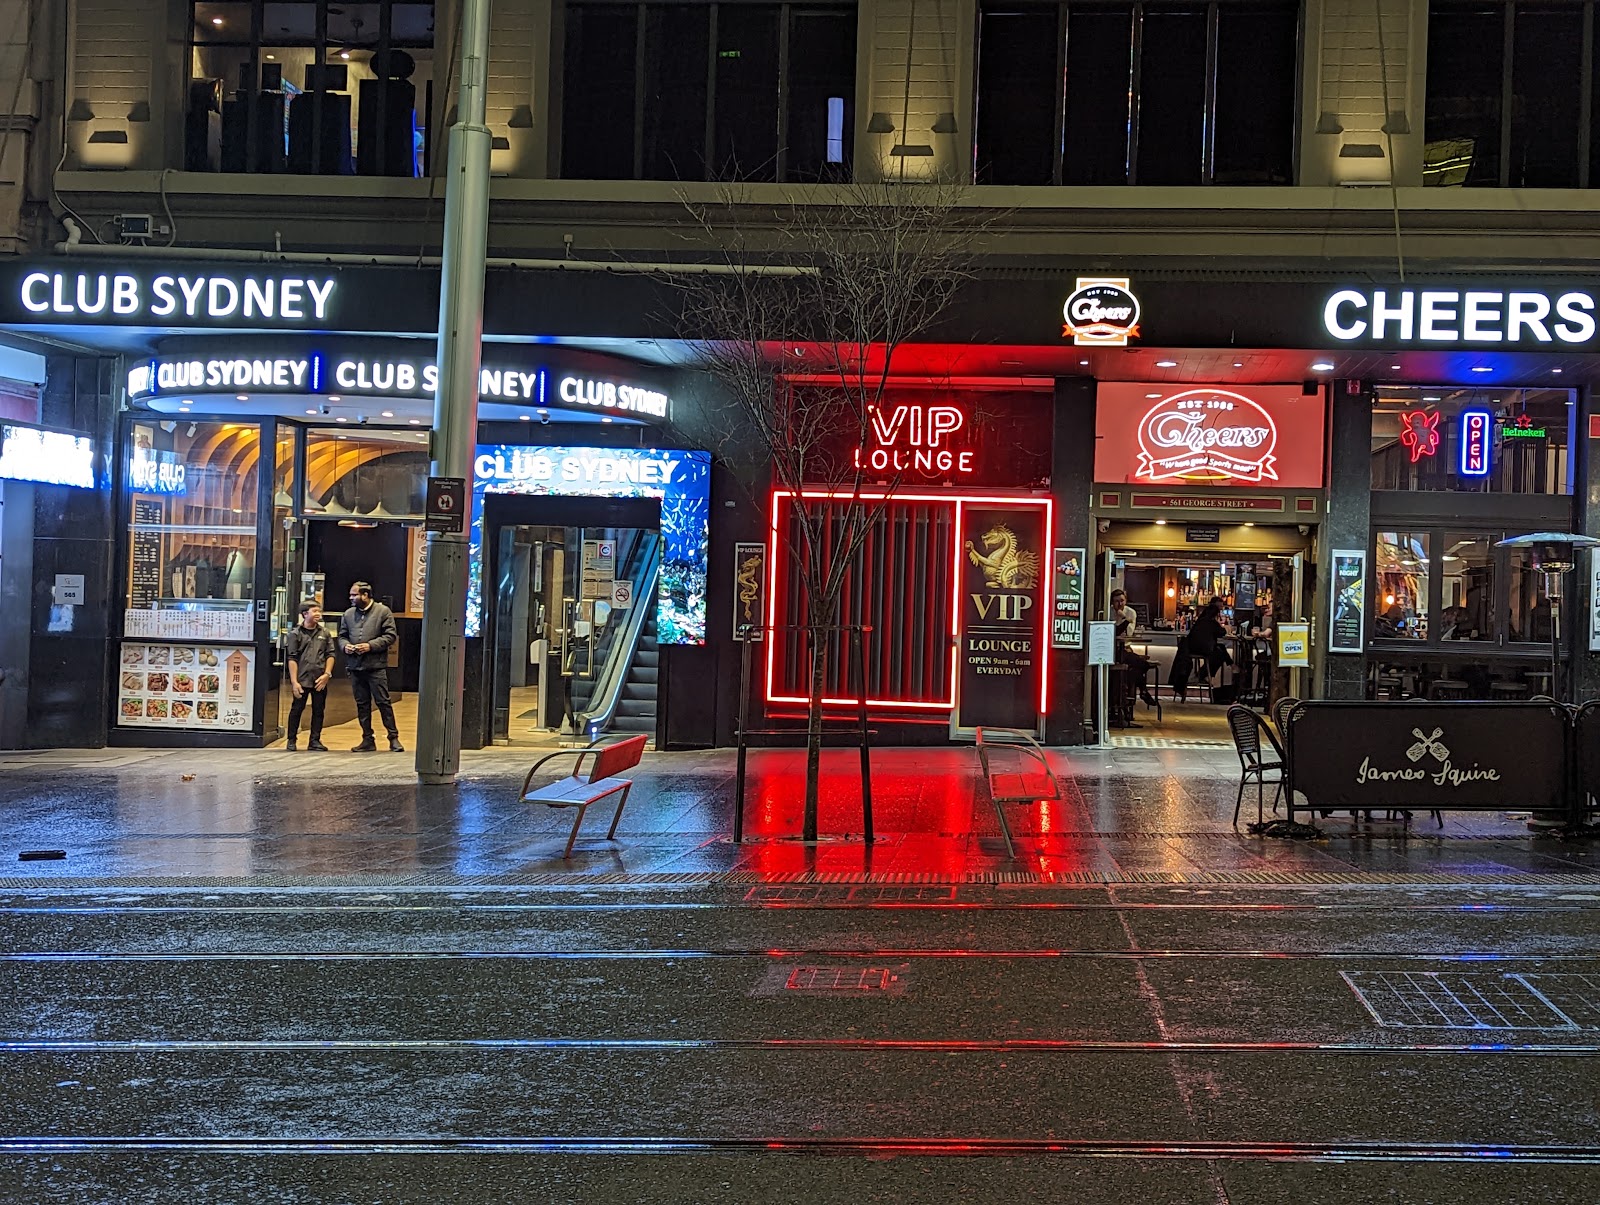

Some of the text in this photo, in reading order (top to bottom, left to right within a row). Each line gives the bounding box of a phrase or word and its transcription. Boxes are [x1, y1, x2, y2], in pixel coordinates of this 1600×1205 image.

[21, 273, 334, 319] CLUB SYDNEY
[1323, 290, 1596, 343] CHEERS
[157, 361, 204, 388] CLUB
[206, 360, 307, 386] SYDNEY
[336, 361, 537, 398] CLUB SNEY
[560, 377, 668, 418] CLUB SYDNEY
[868, 406, 963, 447] VIP
[1148, 411, 1269, 452] Cheers
[1502, 427, 1546, 437] Heineken
[1470, 416, 1482, 469] OPEN
[474, 453, 680, 484] CLUB SYDNEY
[855, 449, 974, 472] LOUNGE
[1183, 499, 1216, 507] GEORGE
[1217, 500, 1248, 508] STREET
[971, 593, 1033, 621] VIP
[1057, 602, 1079, 611] OPEN
[1054, 619, 1081, 633] POOL
[1054, 634, 1081, 642] TABLE
[969, 639, 1032, 652] LOUNGE
[232, 655, 242, 692] 二楼用餐
[968, 656, 992, 664] OPEN
[993, 657, 1009, 665] 9am
[976, 666, 1022, 675] EVERYDAY
[1356, 757, 1500, 786] James Squire
